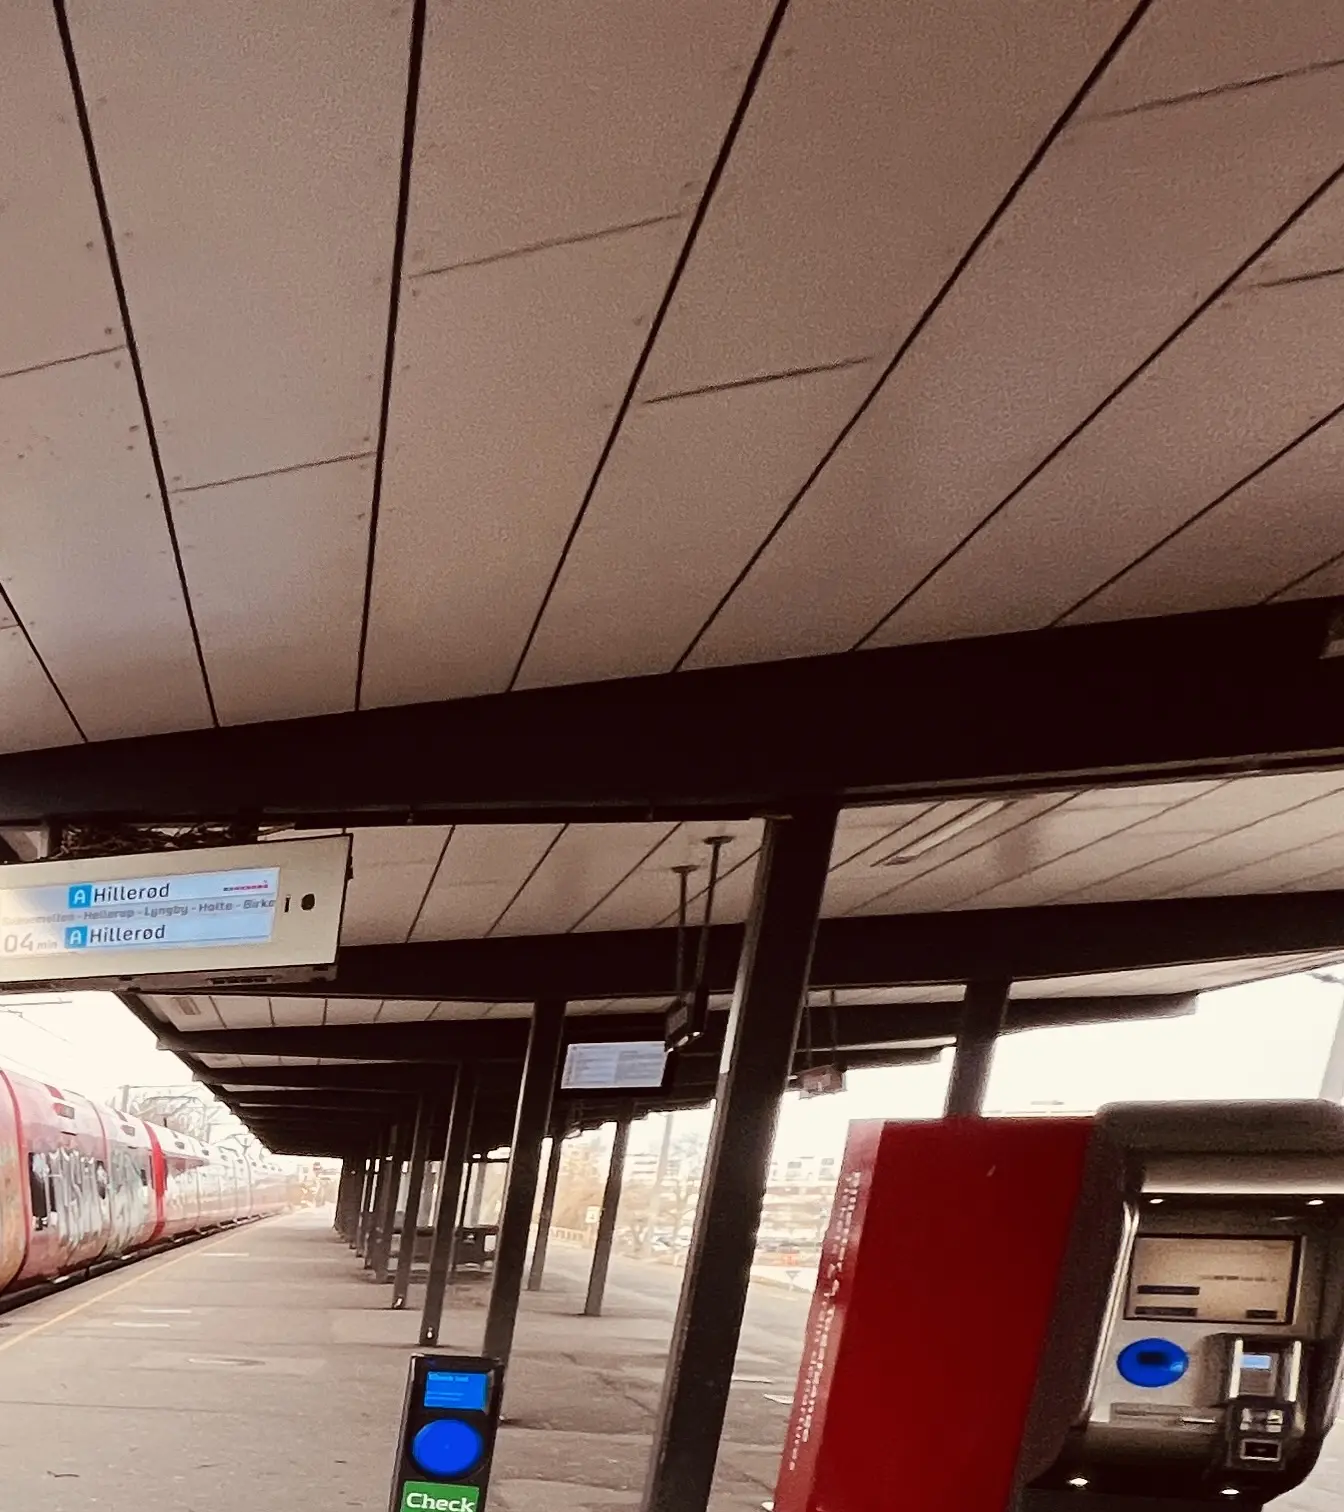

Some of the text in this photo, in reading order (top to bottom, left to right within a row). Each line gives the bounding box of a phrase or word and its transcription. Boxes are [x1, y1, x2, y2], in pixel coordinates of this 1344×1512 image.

[93, 882, 171, 903] Hillerød
[144, 905, 189, 918] Lyngby
[199, 901, 233, 912] Holte
[4, 932, 34, 953] 04
[37, 940, 58, 950] min
[90, 924, 166, 944] Hillerød
